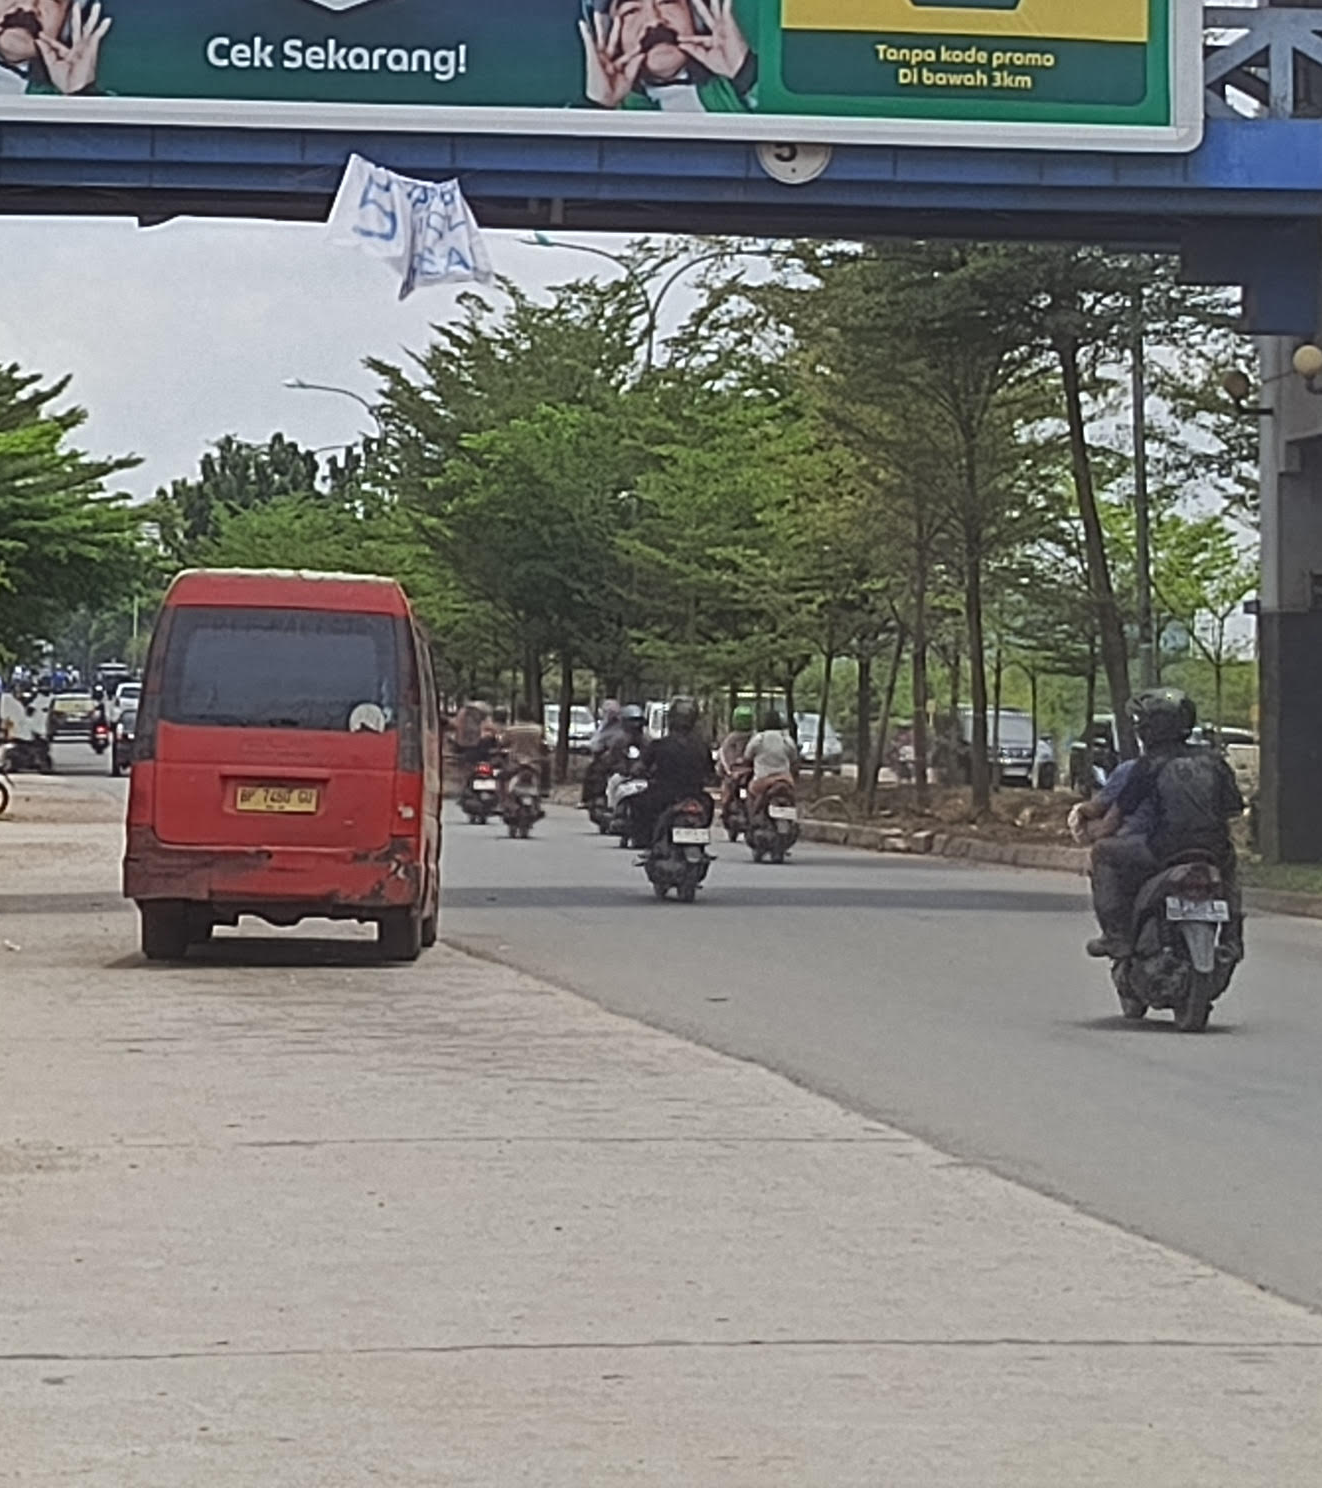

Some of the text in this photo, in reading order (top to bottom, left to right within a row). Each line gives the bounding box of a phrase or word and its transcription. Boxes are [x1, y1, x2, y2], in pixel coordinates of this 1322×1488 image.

[206, 36, 468, 82] Cek Sekarang!
[875, 44, 1056, 68] Tanpa kode promo
[898, 68, 1033, 89] Di bawah 3km
